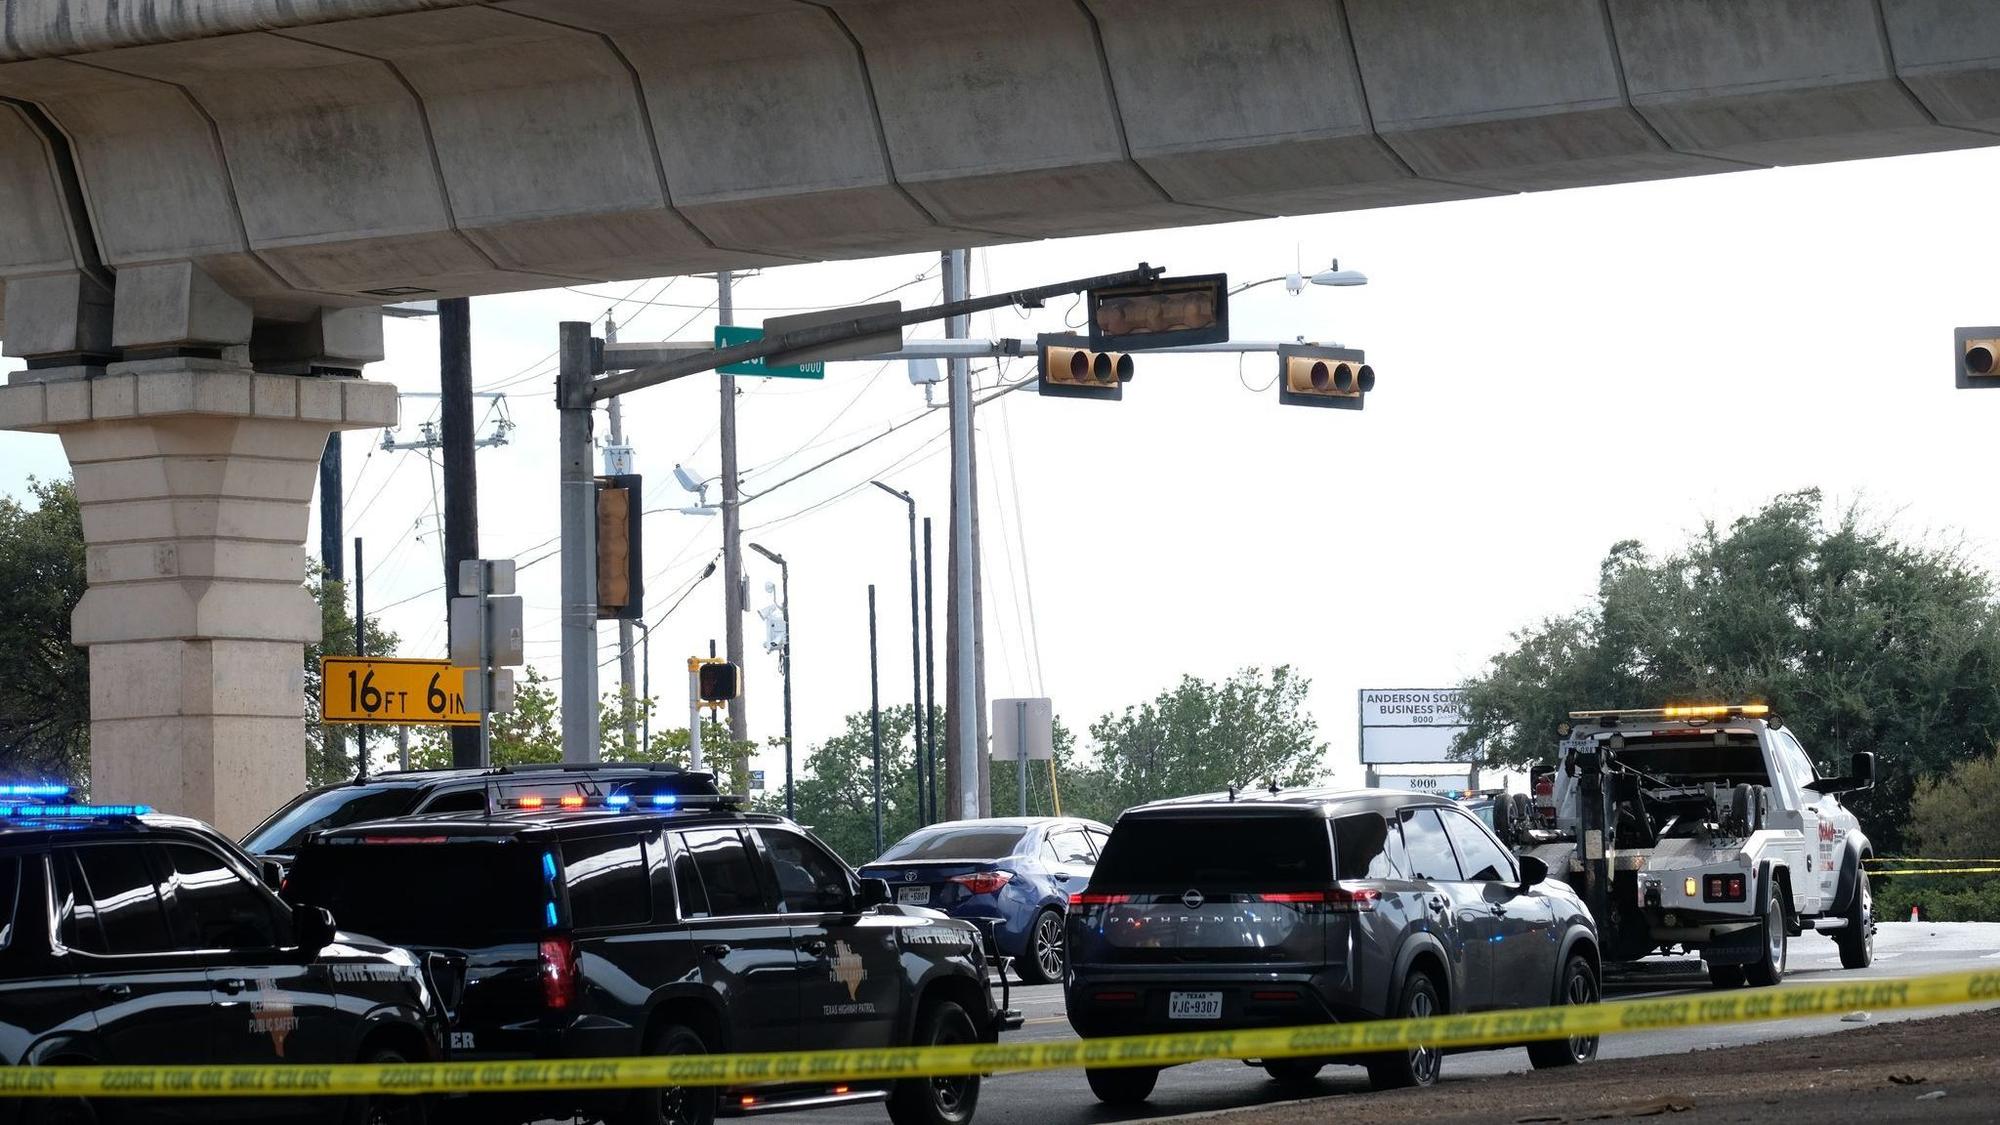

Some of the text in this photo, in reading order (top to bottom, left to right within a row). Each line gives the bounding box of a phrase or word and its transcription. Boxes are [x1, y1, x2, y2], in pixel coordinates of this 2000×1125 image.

[1367, 693, 1431, 703] ANDERSON
[1380, 704, 1434, 714] BUSINESS
[1412, 715, 1434, 723] 8000
[1410, 778, 1437, 788] 8000
[1110, 915, 1282, 923] PATHFINDER
